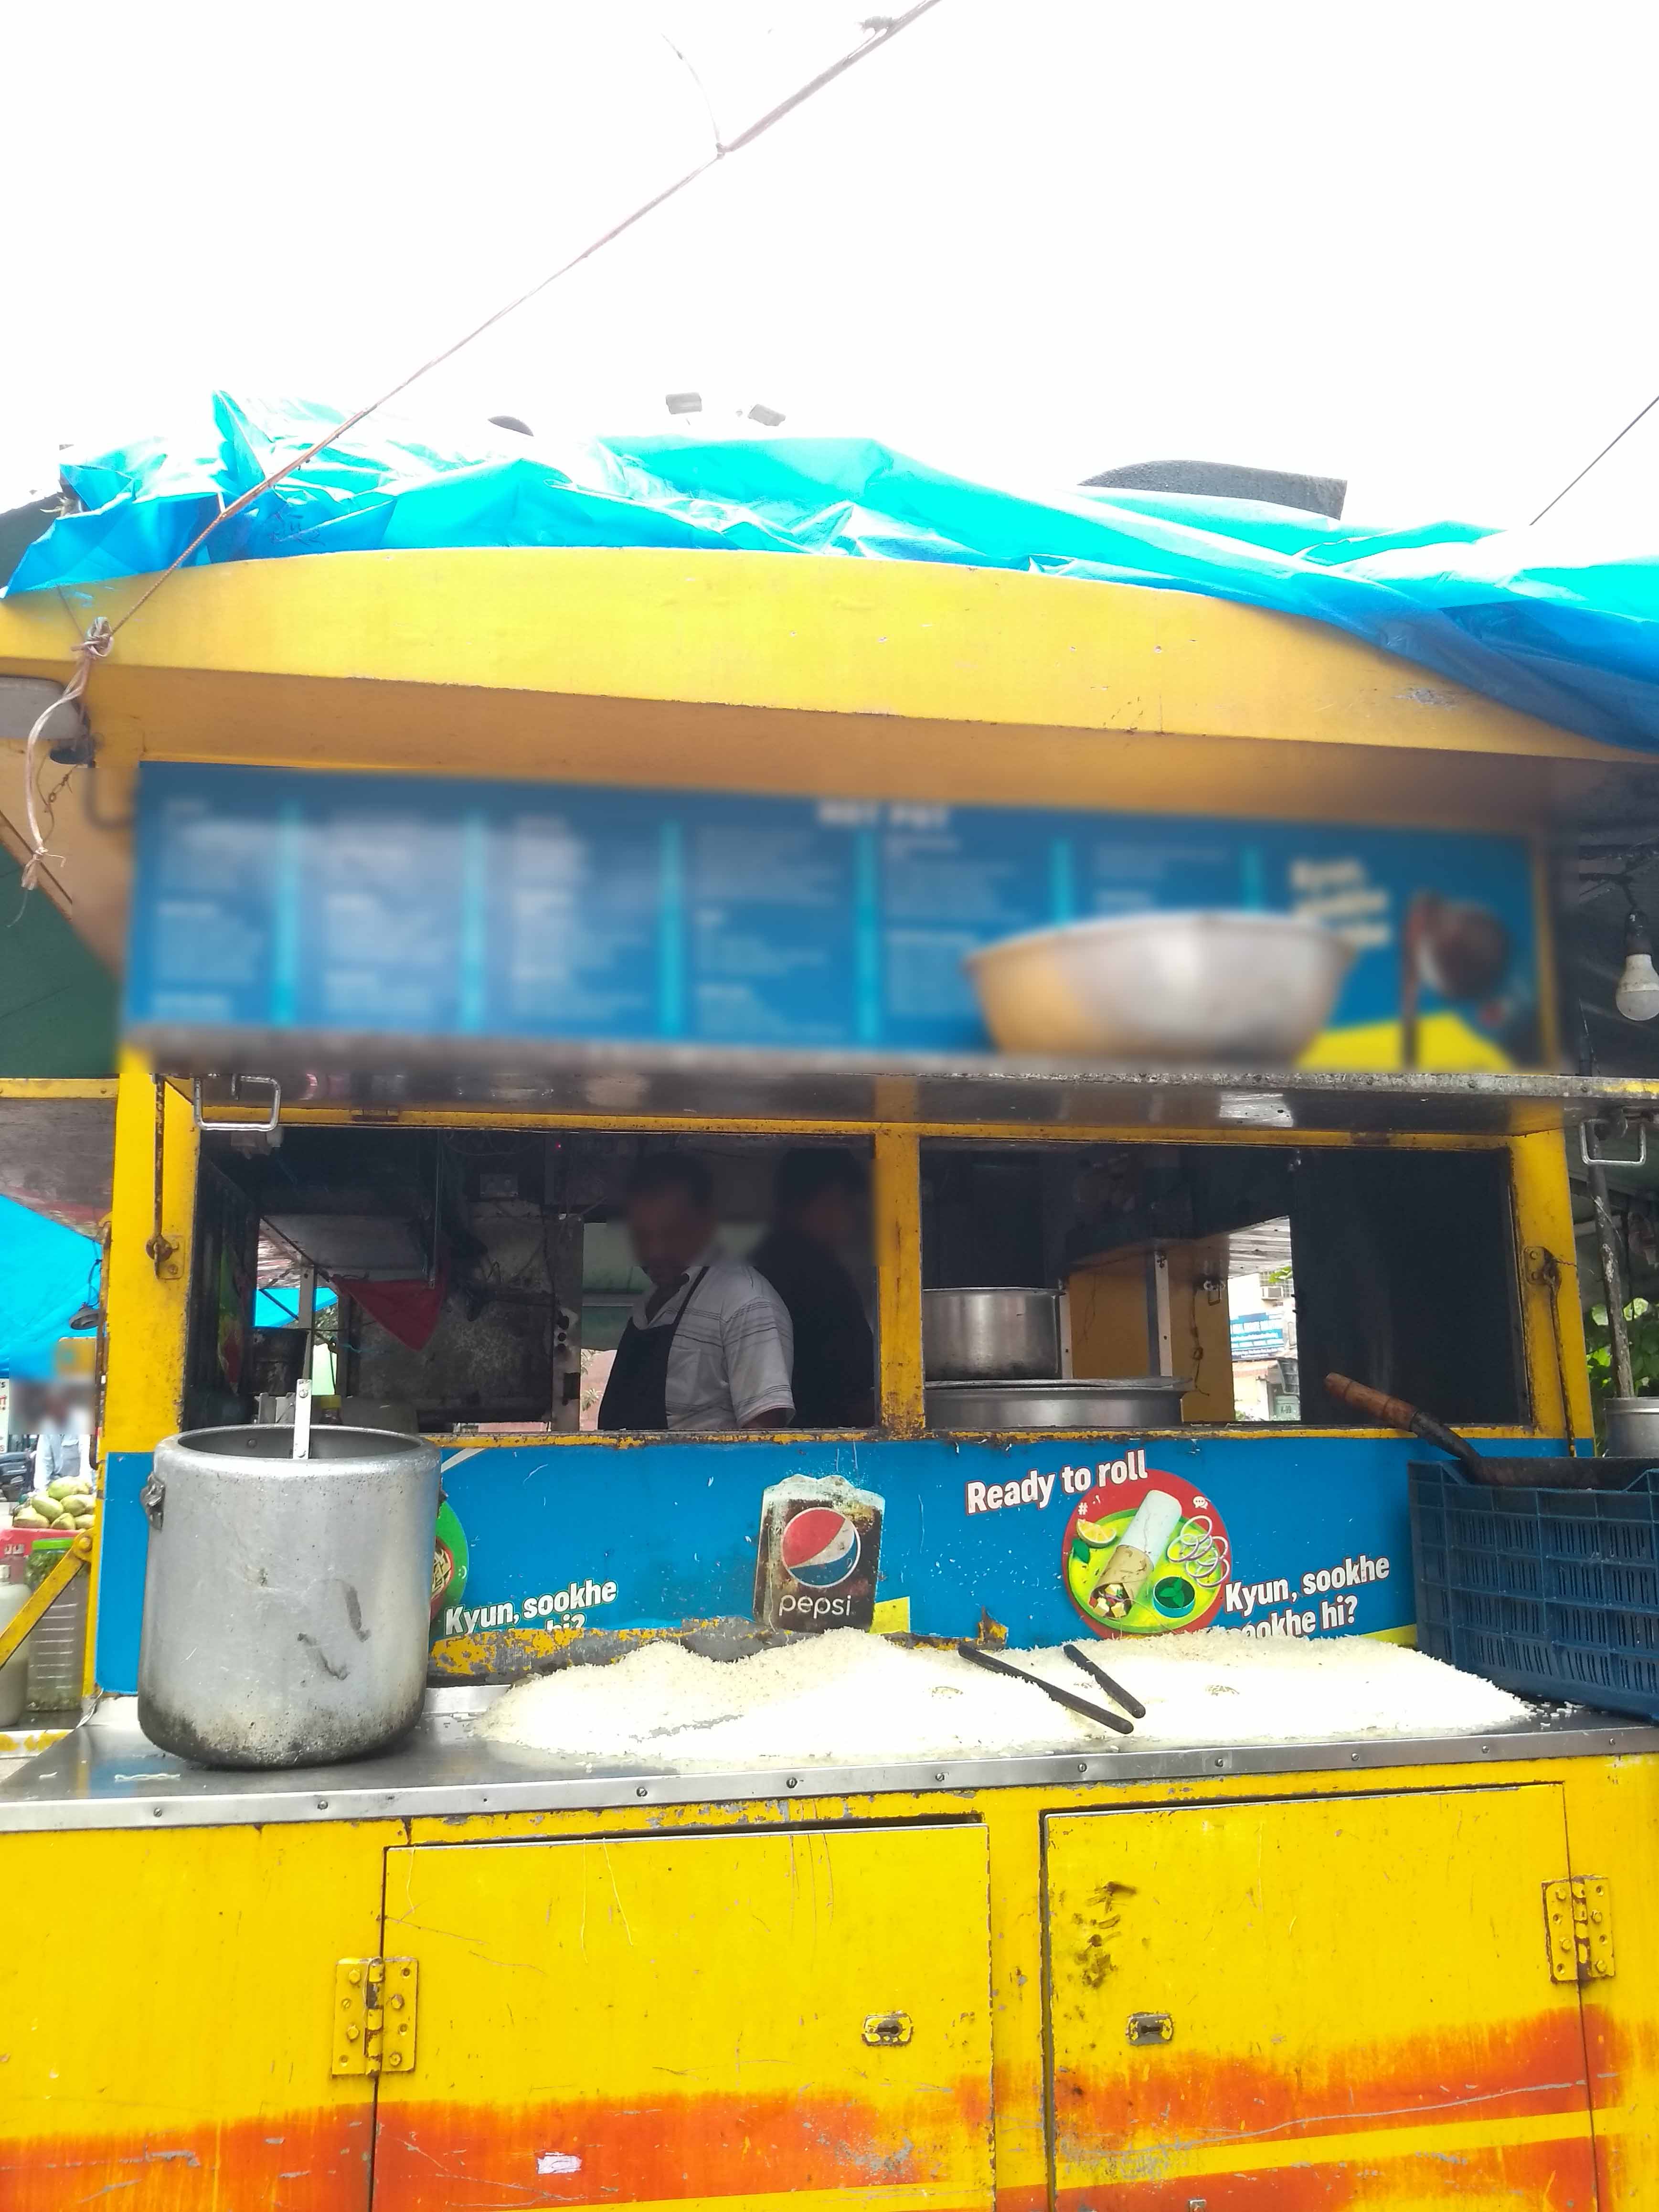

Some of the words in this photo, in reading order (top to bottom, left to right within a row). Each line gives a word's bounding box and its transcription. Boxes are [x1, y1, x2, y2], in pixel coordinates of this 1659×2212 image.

[967, 1469, 1055, 1514] Ready
[1061, 1466, 1091, 1493] to
[1098, 1448, 1148, 1487] roll
[445, 1601, 520, 1636] Kyun,
[523, 1578, 618, 1619] sookhe
[778, 1594, 851, 1619] pepsi
[1225, 1578, 1297, 1617] Kyun,
[1302, 1554, 1390, 1595] sookhe
[1227, 1609, 1317, 1638] ookhe
[1321, 1595, 1358, 1629] hi?
